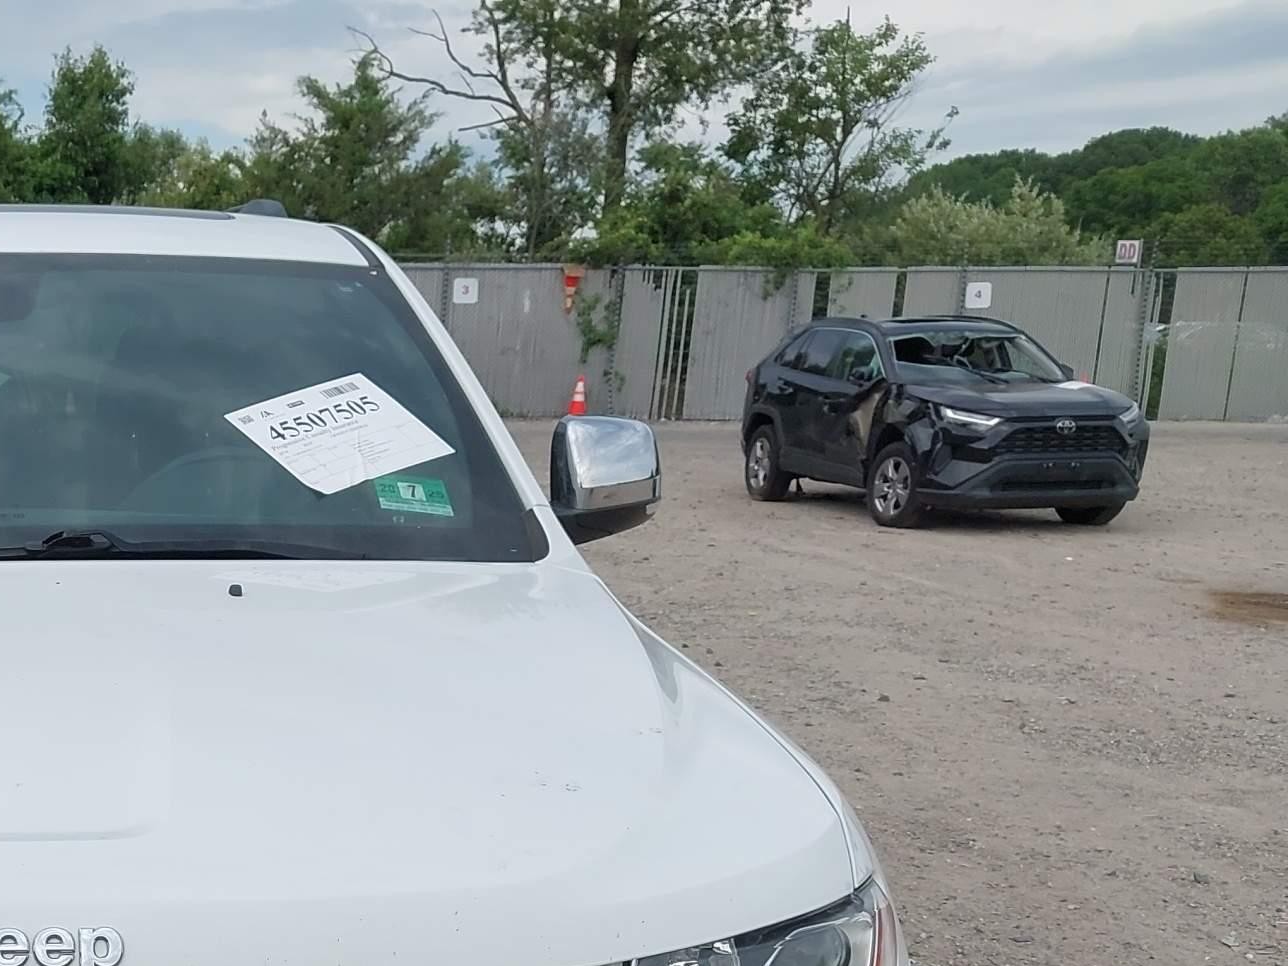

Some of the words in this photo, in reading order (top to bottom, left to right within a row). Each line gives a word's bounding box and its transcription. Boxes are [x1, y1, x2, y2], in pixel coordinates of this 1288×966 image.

[461, 284, 470, 295] 3
[269, 396, 381, 441] 45507505
[407, 485, 416, 497] 7
